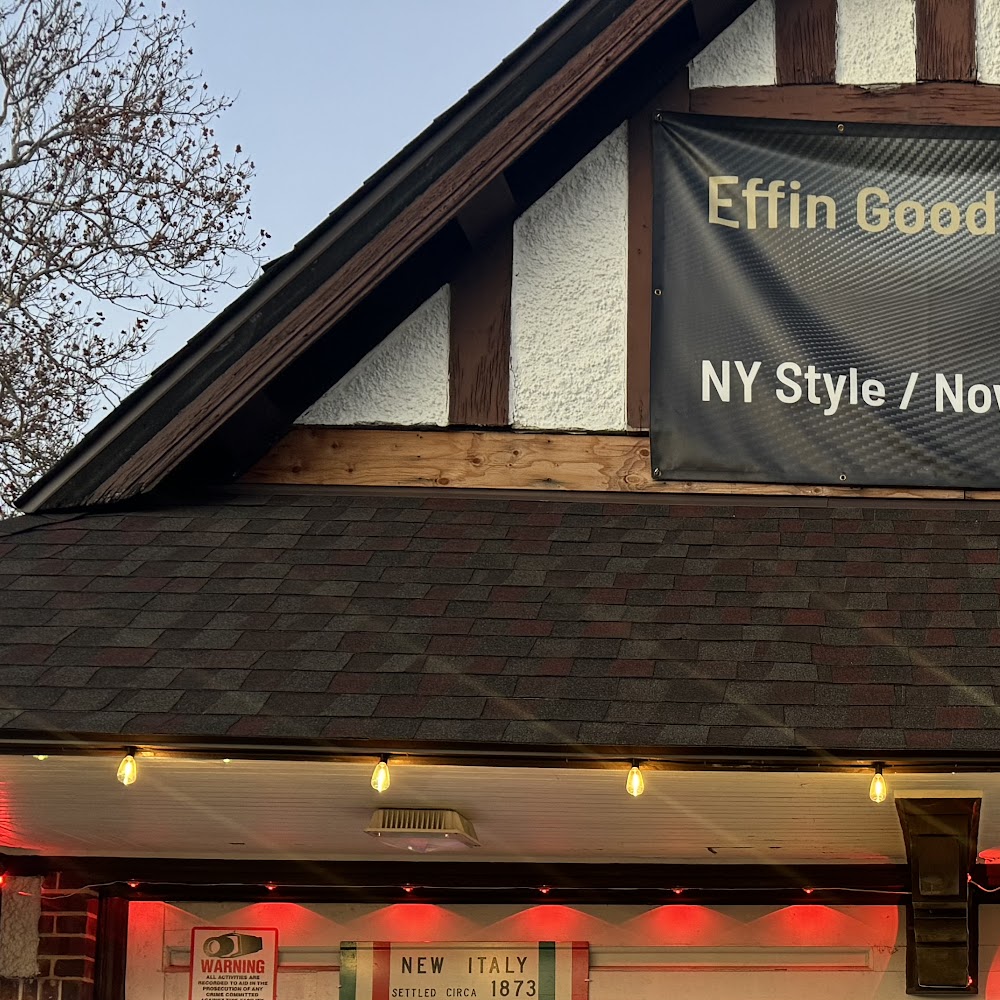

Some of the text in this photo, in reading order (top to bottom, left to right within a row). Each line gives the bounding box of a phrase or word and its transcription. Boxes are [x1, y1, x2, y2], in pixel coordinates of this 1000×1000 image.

[708, 174, 836, 230] Effin
[855, 186, 995, 236] Good
[702, 359, 762, 403] NY
[775, 361, 886, 416] Style
[899, 372, 917, 410] /
[200, 959, 266, 974] WARNING
[401, 956, 528, 975] NEW ITALY
[391, 980, 537, 999] SETTLED CIRCA 1873
